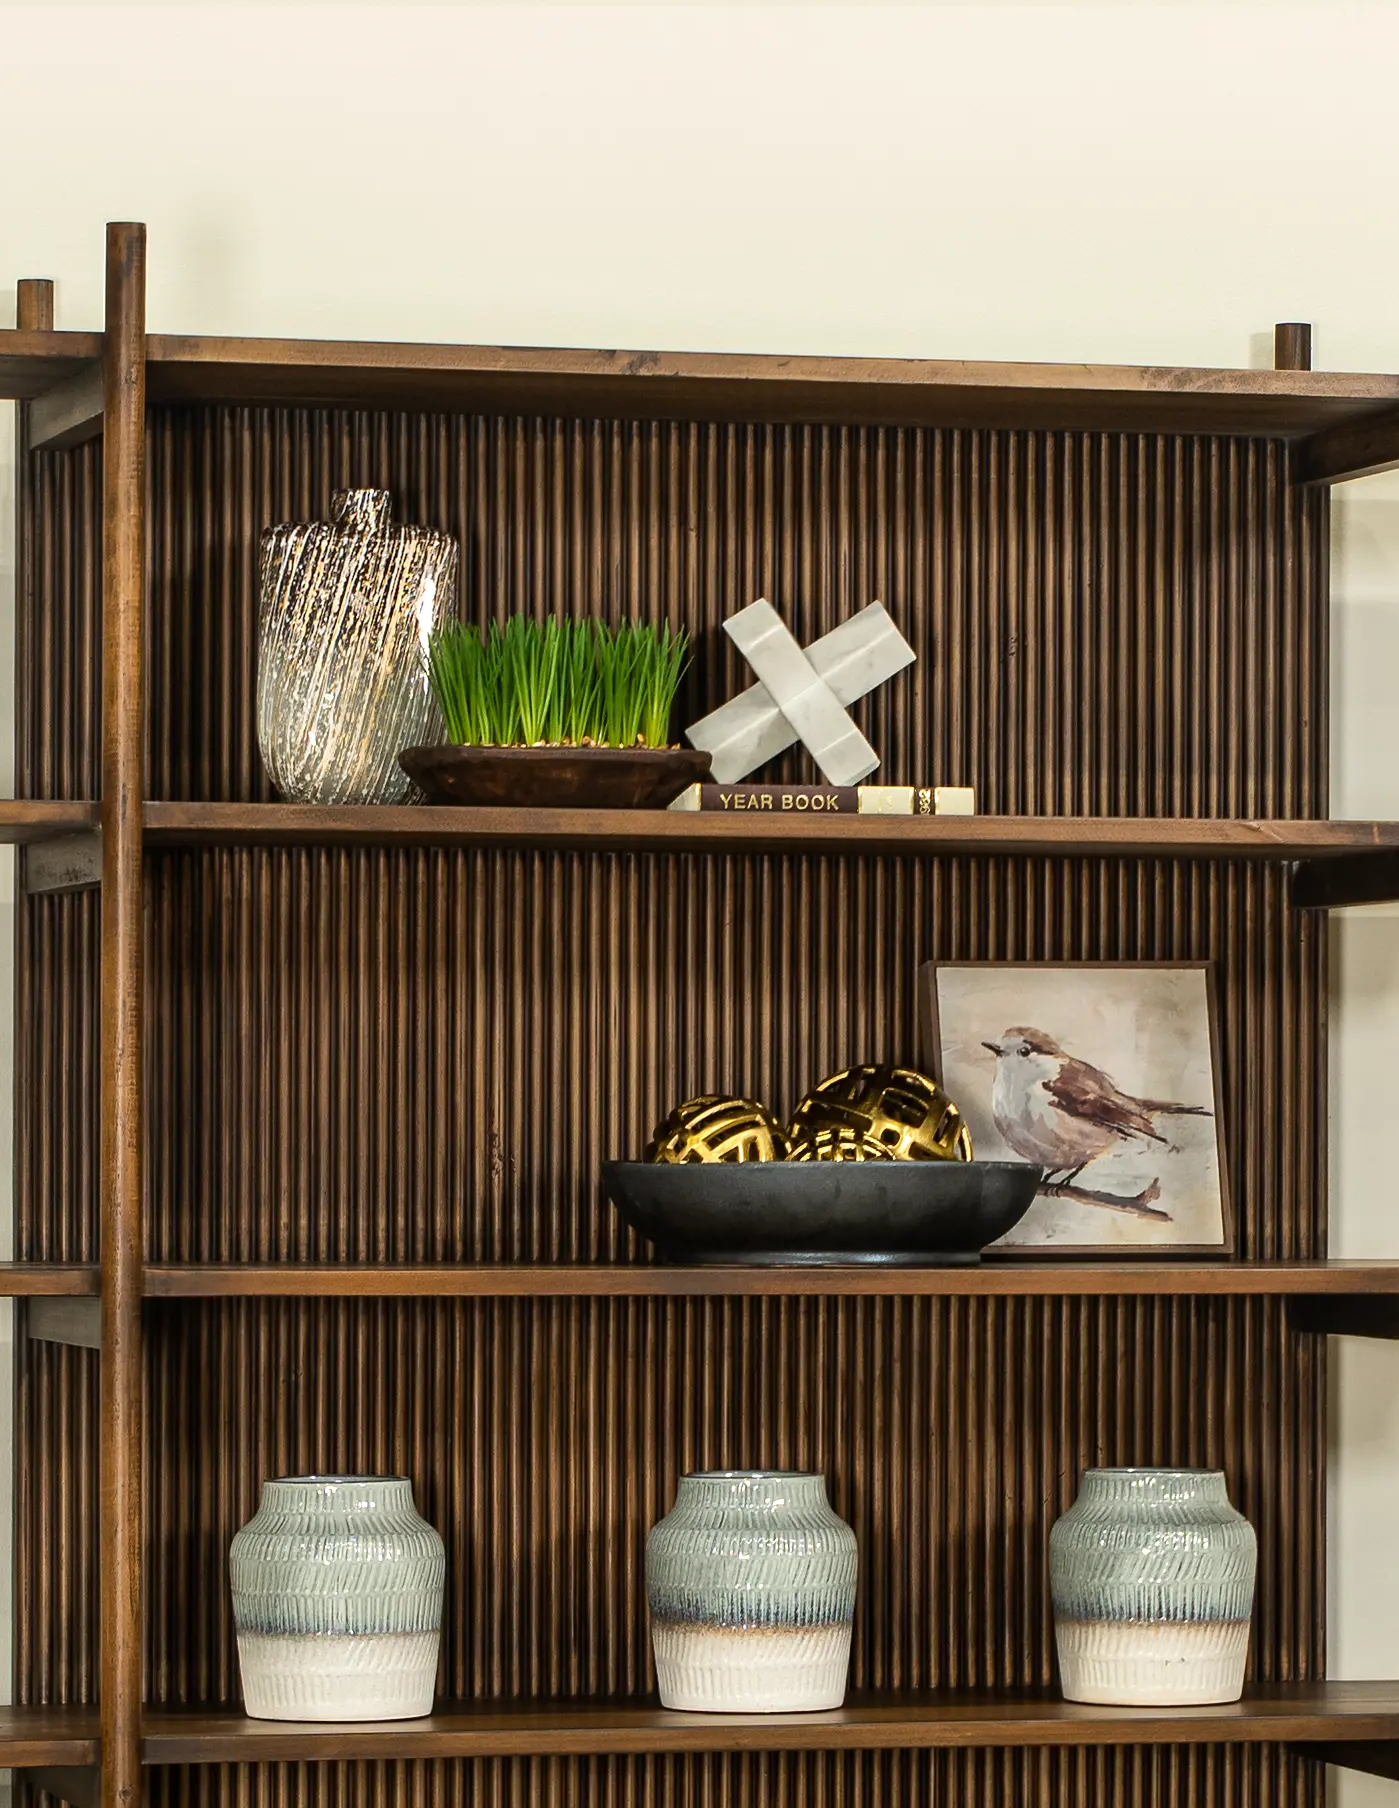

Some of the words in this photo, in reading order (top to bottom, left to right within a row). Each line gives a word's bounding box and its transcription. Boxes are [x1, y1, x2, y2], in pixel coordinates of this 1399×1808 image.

[719, 793, 774, 810] YEAR
[781, 794, 840, 811] BOOK
[918, 788, 931, 815] 982
